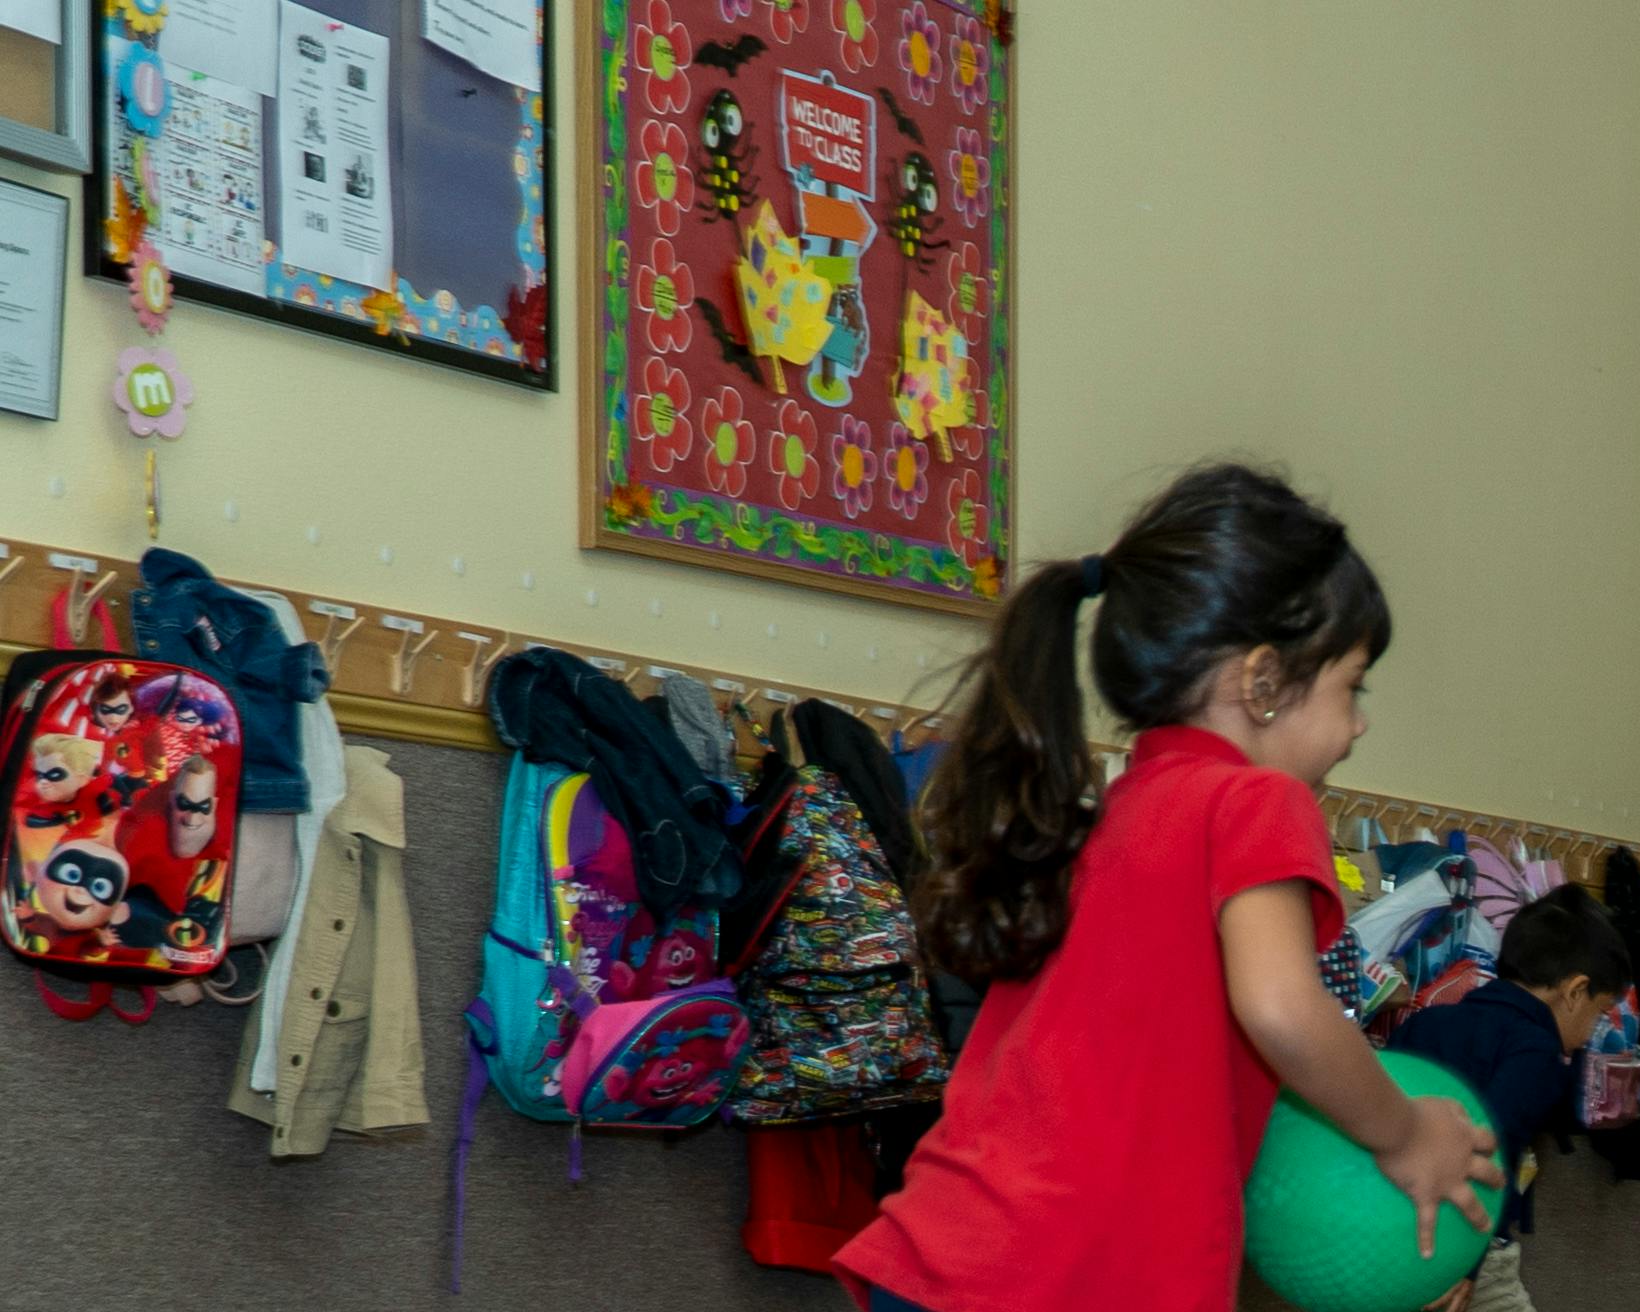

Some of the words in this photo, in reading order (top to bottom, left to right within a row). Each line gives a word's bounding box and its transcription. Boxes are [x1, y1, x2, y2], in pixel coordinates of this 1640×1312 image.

[792, 96, 863, 144] WELCOME
[793, 126, 813, 148] TO
[814, 136, 862, 173] CLASS
